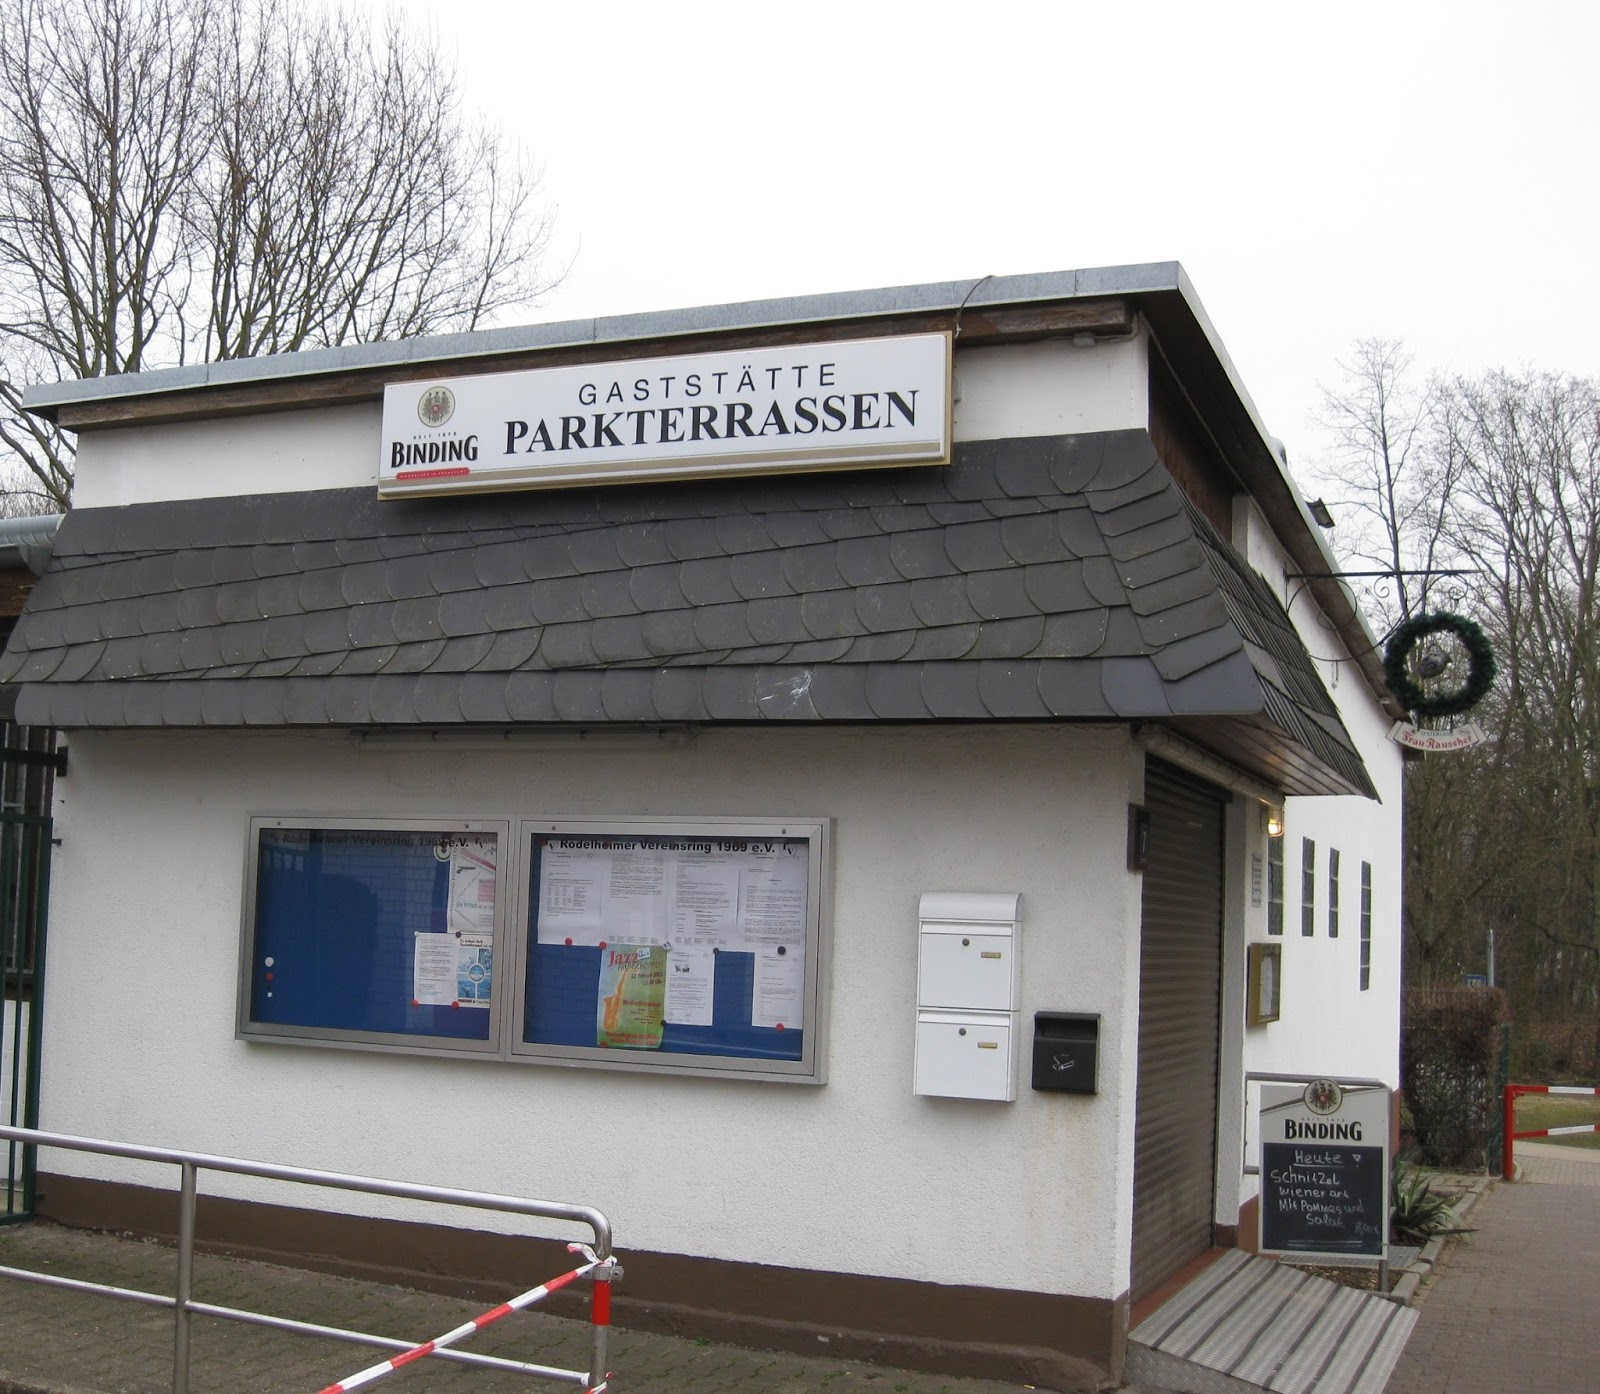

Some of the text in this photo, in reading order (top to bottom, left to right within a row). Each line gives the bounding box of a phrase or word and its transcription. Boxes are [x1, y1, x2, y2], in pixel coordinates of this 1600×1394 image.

[578, 361, 837, 406] GASTSTÄTTE
[503, 389, 920, 456] PARKTERRASSEN
[391, 435, 479, 468] BINDING
[1402, 730, 1473, 749] Frau Rauscher
[641, 840, 712, 854] Vereinsring
[717, 841, 748, 852] 1969
[752, 842, 776, 853] e.V.
[608, 950, 639, 967] Jazz
[1284, 1118, 1362, 1141] BINDING
[1294, 1150, 1343, 1164] Heute
